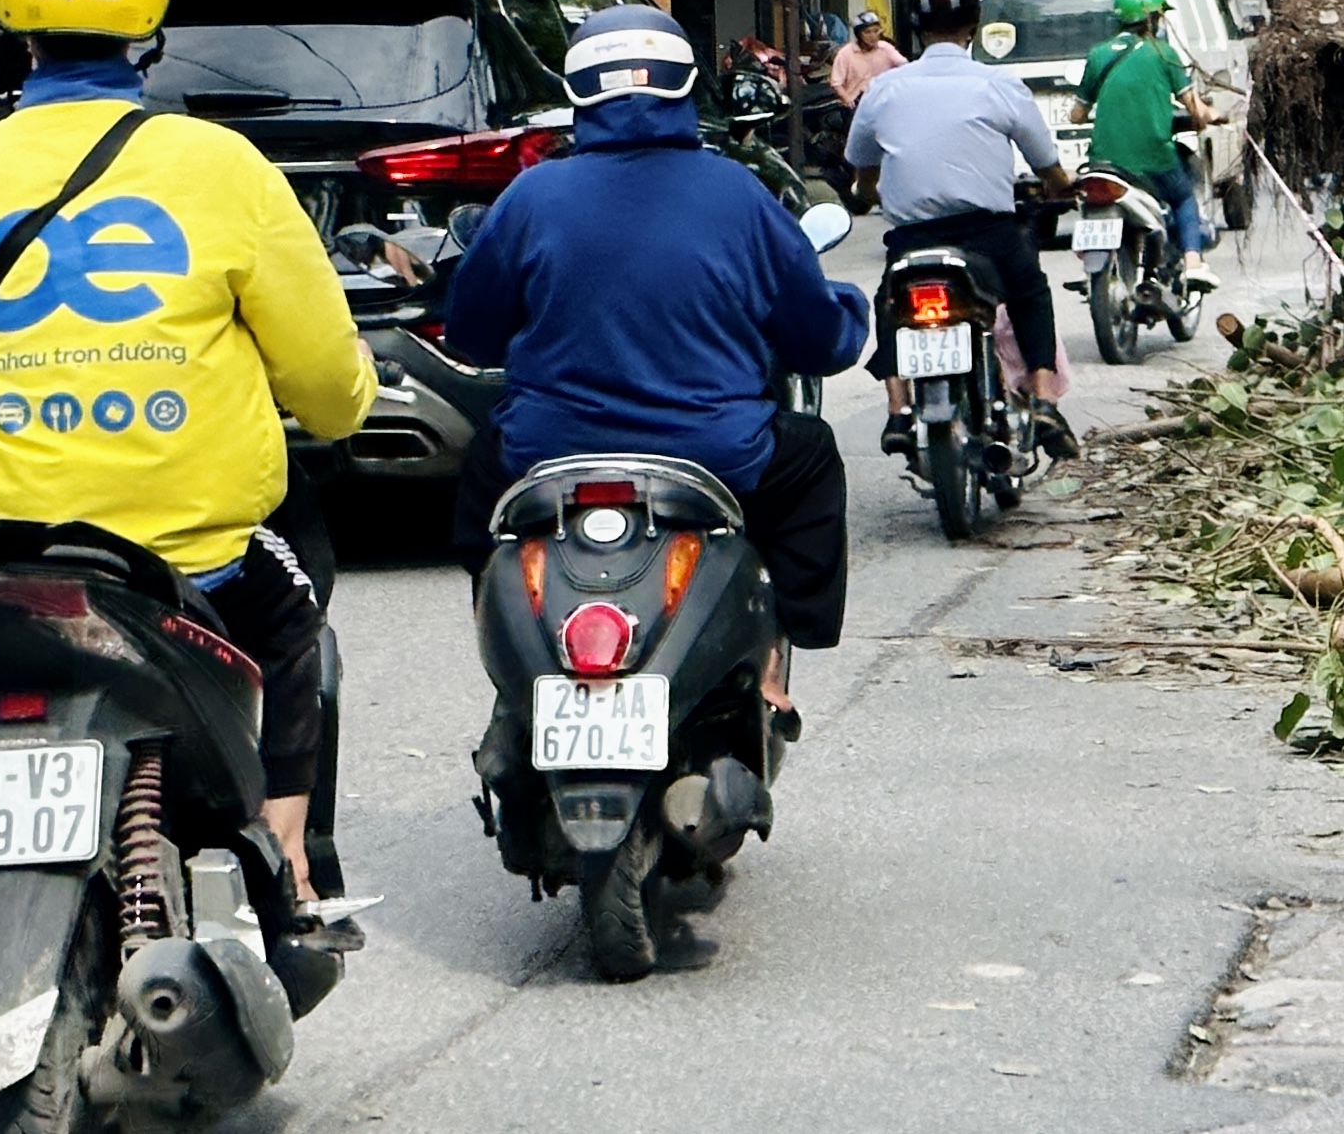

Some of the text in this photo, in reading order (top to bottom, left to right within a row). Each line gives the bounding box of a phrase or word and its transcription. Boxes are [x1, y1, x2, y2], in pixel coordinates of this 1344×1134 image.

[909, 327, 960, 351] 18-Z1
[54, 346, 102, 368] trọn
[108, 340, 188, 366] đường
[909, 350, 961, 374] 9648
[555, 682, 646, 720] 29-AA
[543, 723, 656, 763] 670.43
